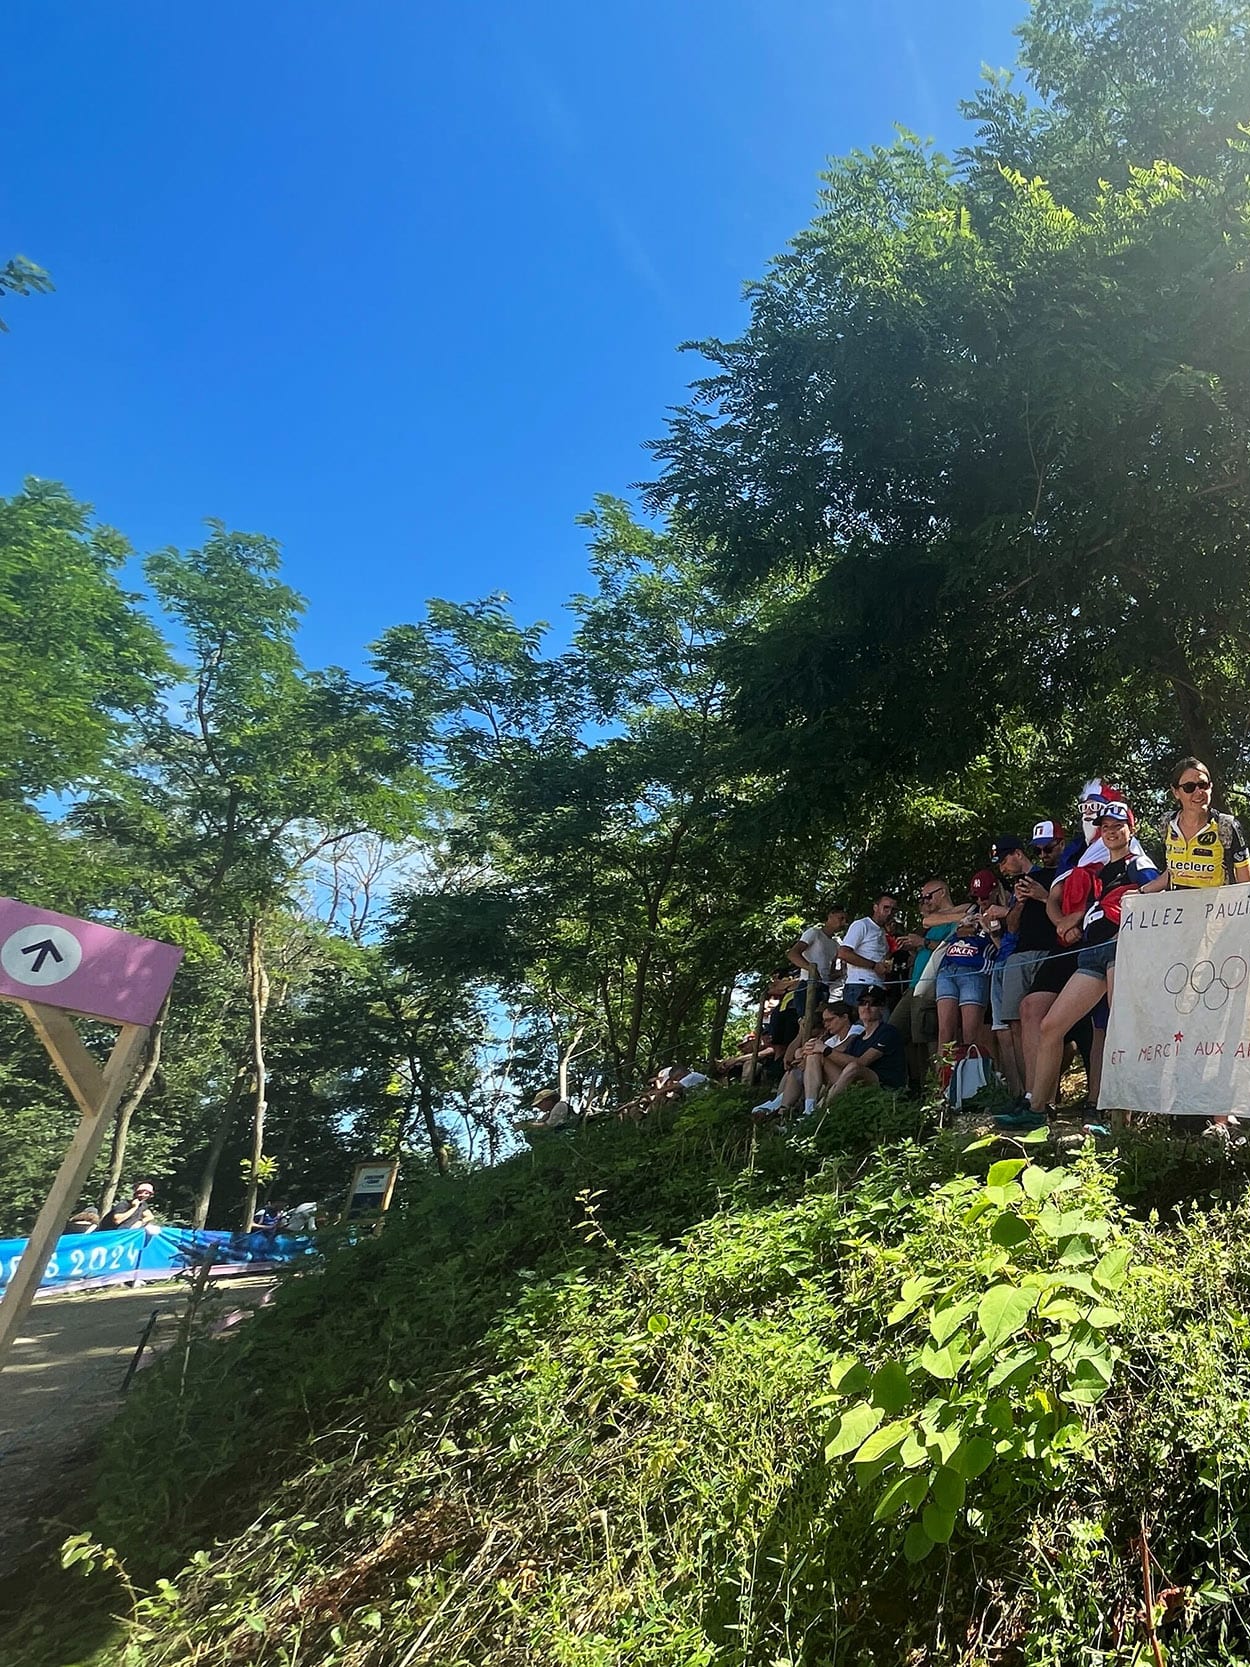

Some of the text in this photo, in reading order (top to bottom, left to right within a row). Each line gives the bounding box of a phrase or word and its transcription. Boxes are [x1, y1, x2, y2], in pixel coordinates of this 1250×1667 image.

[1170, 860, 1215, 872] Leclerc
[1121, 908, 1184, 932] ALLEZ
[1111, 1049, 1126, 1065] ET
[1137, 1042, 1180, 1062] MERCI
[1194, 1041, 1225, 1056] AUX
[70, 1242, 139, 1276] 2024
